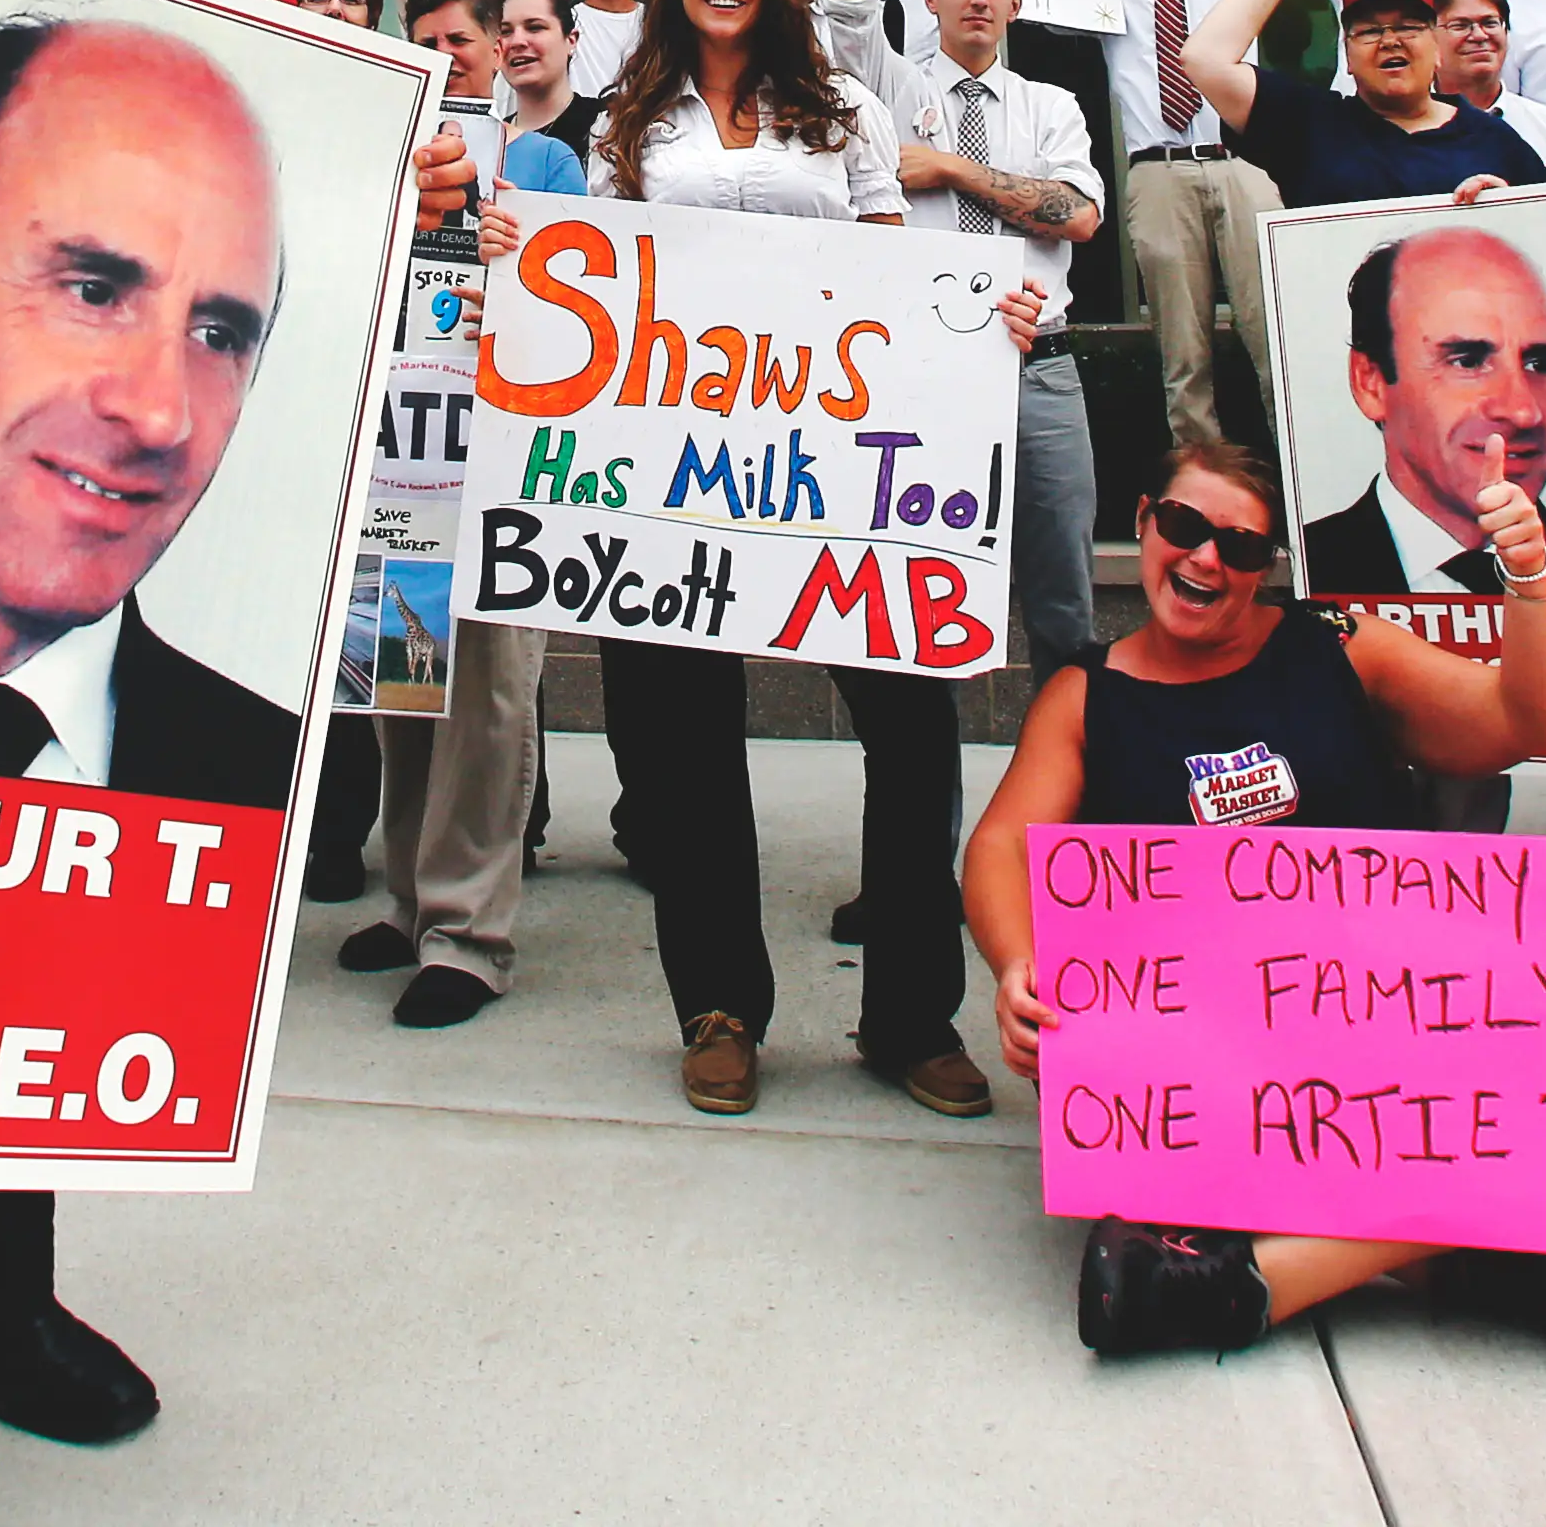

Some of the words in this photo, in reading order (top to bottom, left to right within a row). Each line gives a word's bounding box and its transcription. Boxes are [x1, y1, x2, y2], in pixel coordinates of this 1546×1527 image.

[441, 233, 479, 245] DEMOU
[415, 270, 471, 290] STORE
[431, 289, 462, 334] 9
[475, 220, 891, 421] Shaw's
[400, 362, 439, 370] Market
[519, 426, 634, 509] Has
[663, 428, 825, 523] Milk
[855, 431, 1003, 549] Too!
[387, 539, 440, 551] BASKET
[475, 507, 737, 638] Boycott
[768, 544, 994, 668] MB
[1186, 756, 1228, 780] We
[1231, 744, 1270, 771] are
[1203, 764, 1277, 798] MARKET
[1210, 785, 1281, 816] BASKET
[156, 821, 232, 909] T.
[1044, 838, 1183, 912] ONE
[1224, 837, 1531, 944] COMPANY
[1054, 954, 1189, 1016] ONE
[1062, 1083, 1200, 1152] ONE
[1251, 1077, 1512, 1171] ARTIE
